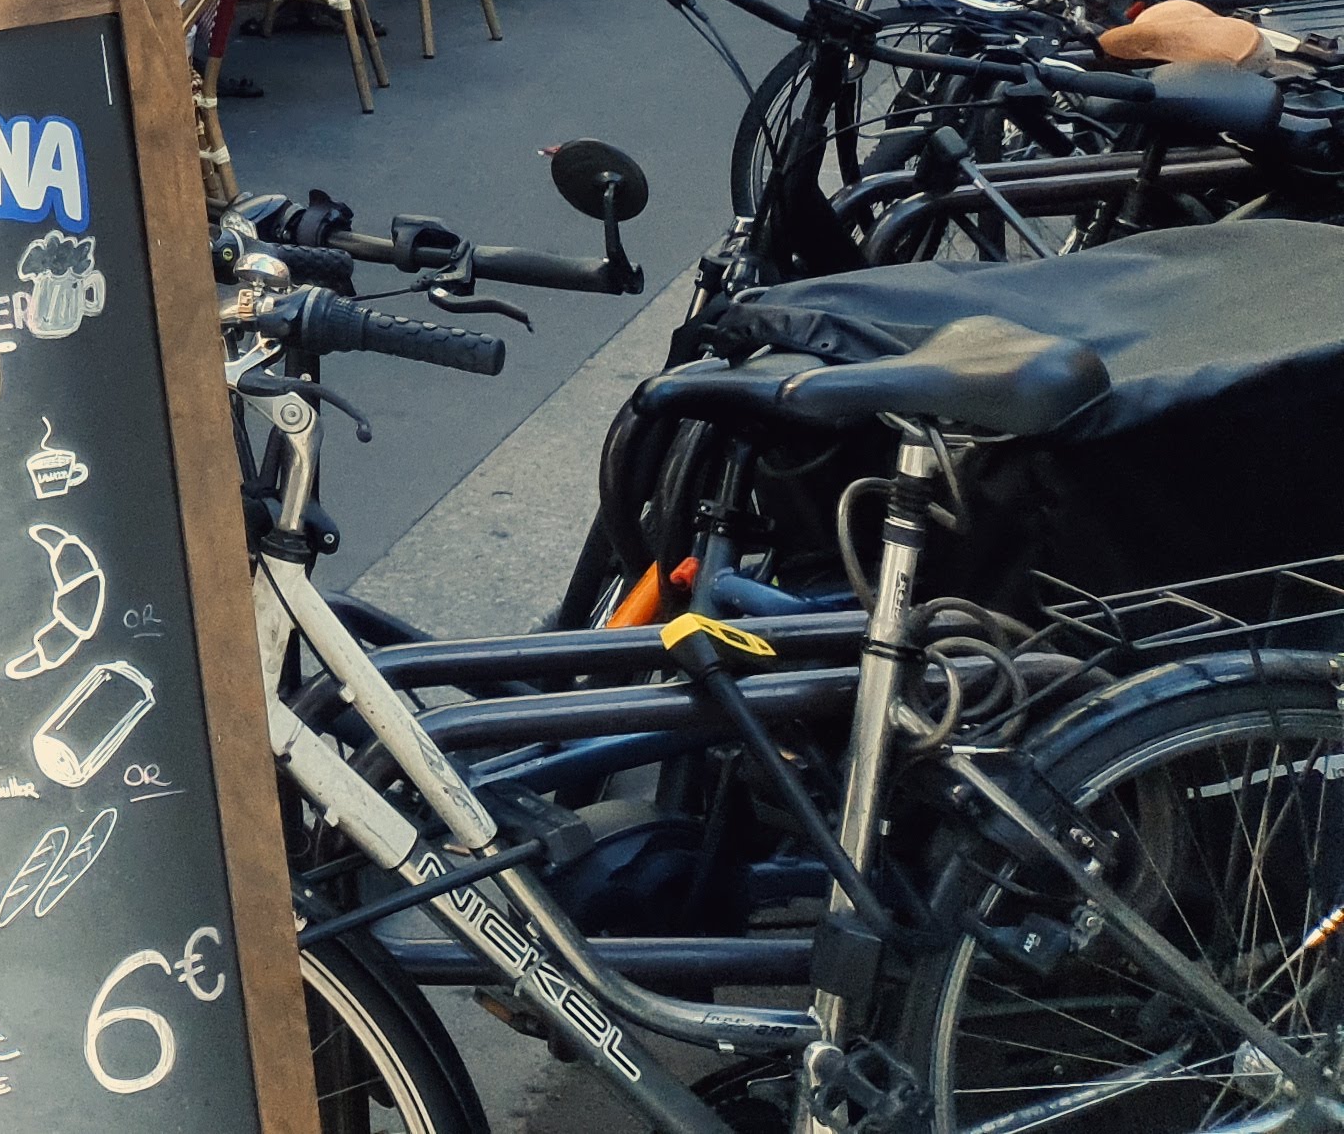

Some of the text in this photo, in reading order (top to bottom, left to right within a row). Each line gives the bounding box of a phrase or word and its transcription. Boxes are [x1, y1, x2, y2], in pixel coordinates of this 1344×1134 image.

[123, 607, 164, 633] OR
[123, 762, 174, 790] OR
[416, 851, 642, 1083] NICKEL
